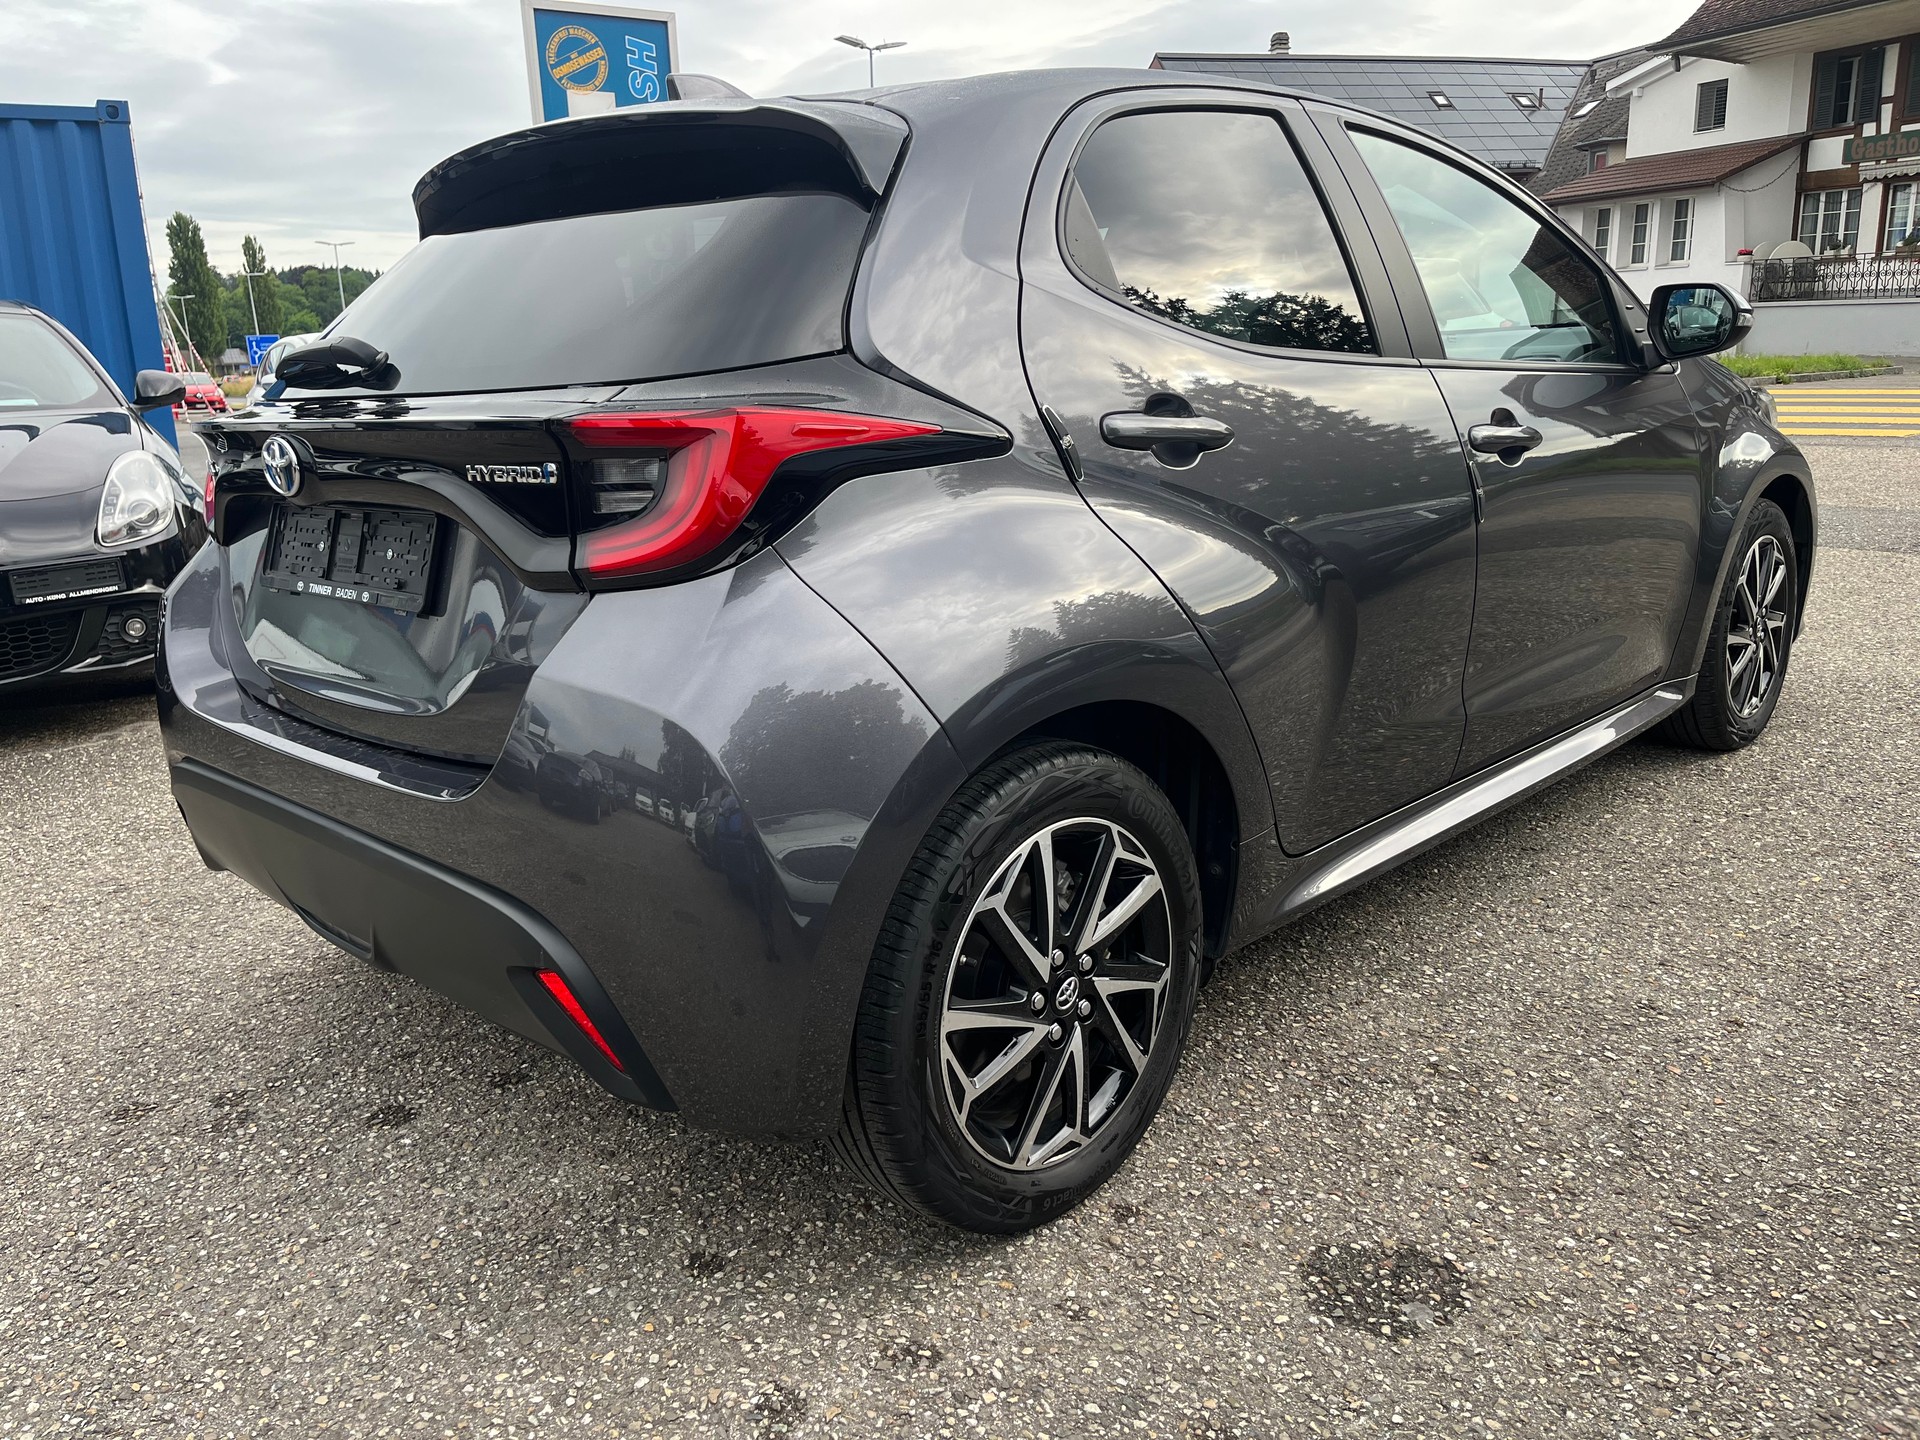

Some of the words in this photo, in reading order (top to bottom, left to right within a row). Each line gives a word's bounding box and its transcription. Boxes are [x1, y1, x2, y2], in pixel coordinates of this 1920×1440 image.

[1851, 133, 1920, 160] Gastho
[465, 464, 542, 484] HYBRID
[69, 585, 119, 598] ALLMENDINGEN
[308, 583, 333, 596] TINNER
[335, 587, 358, 600] BADEN
